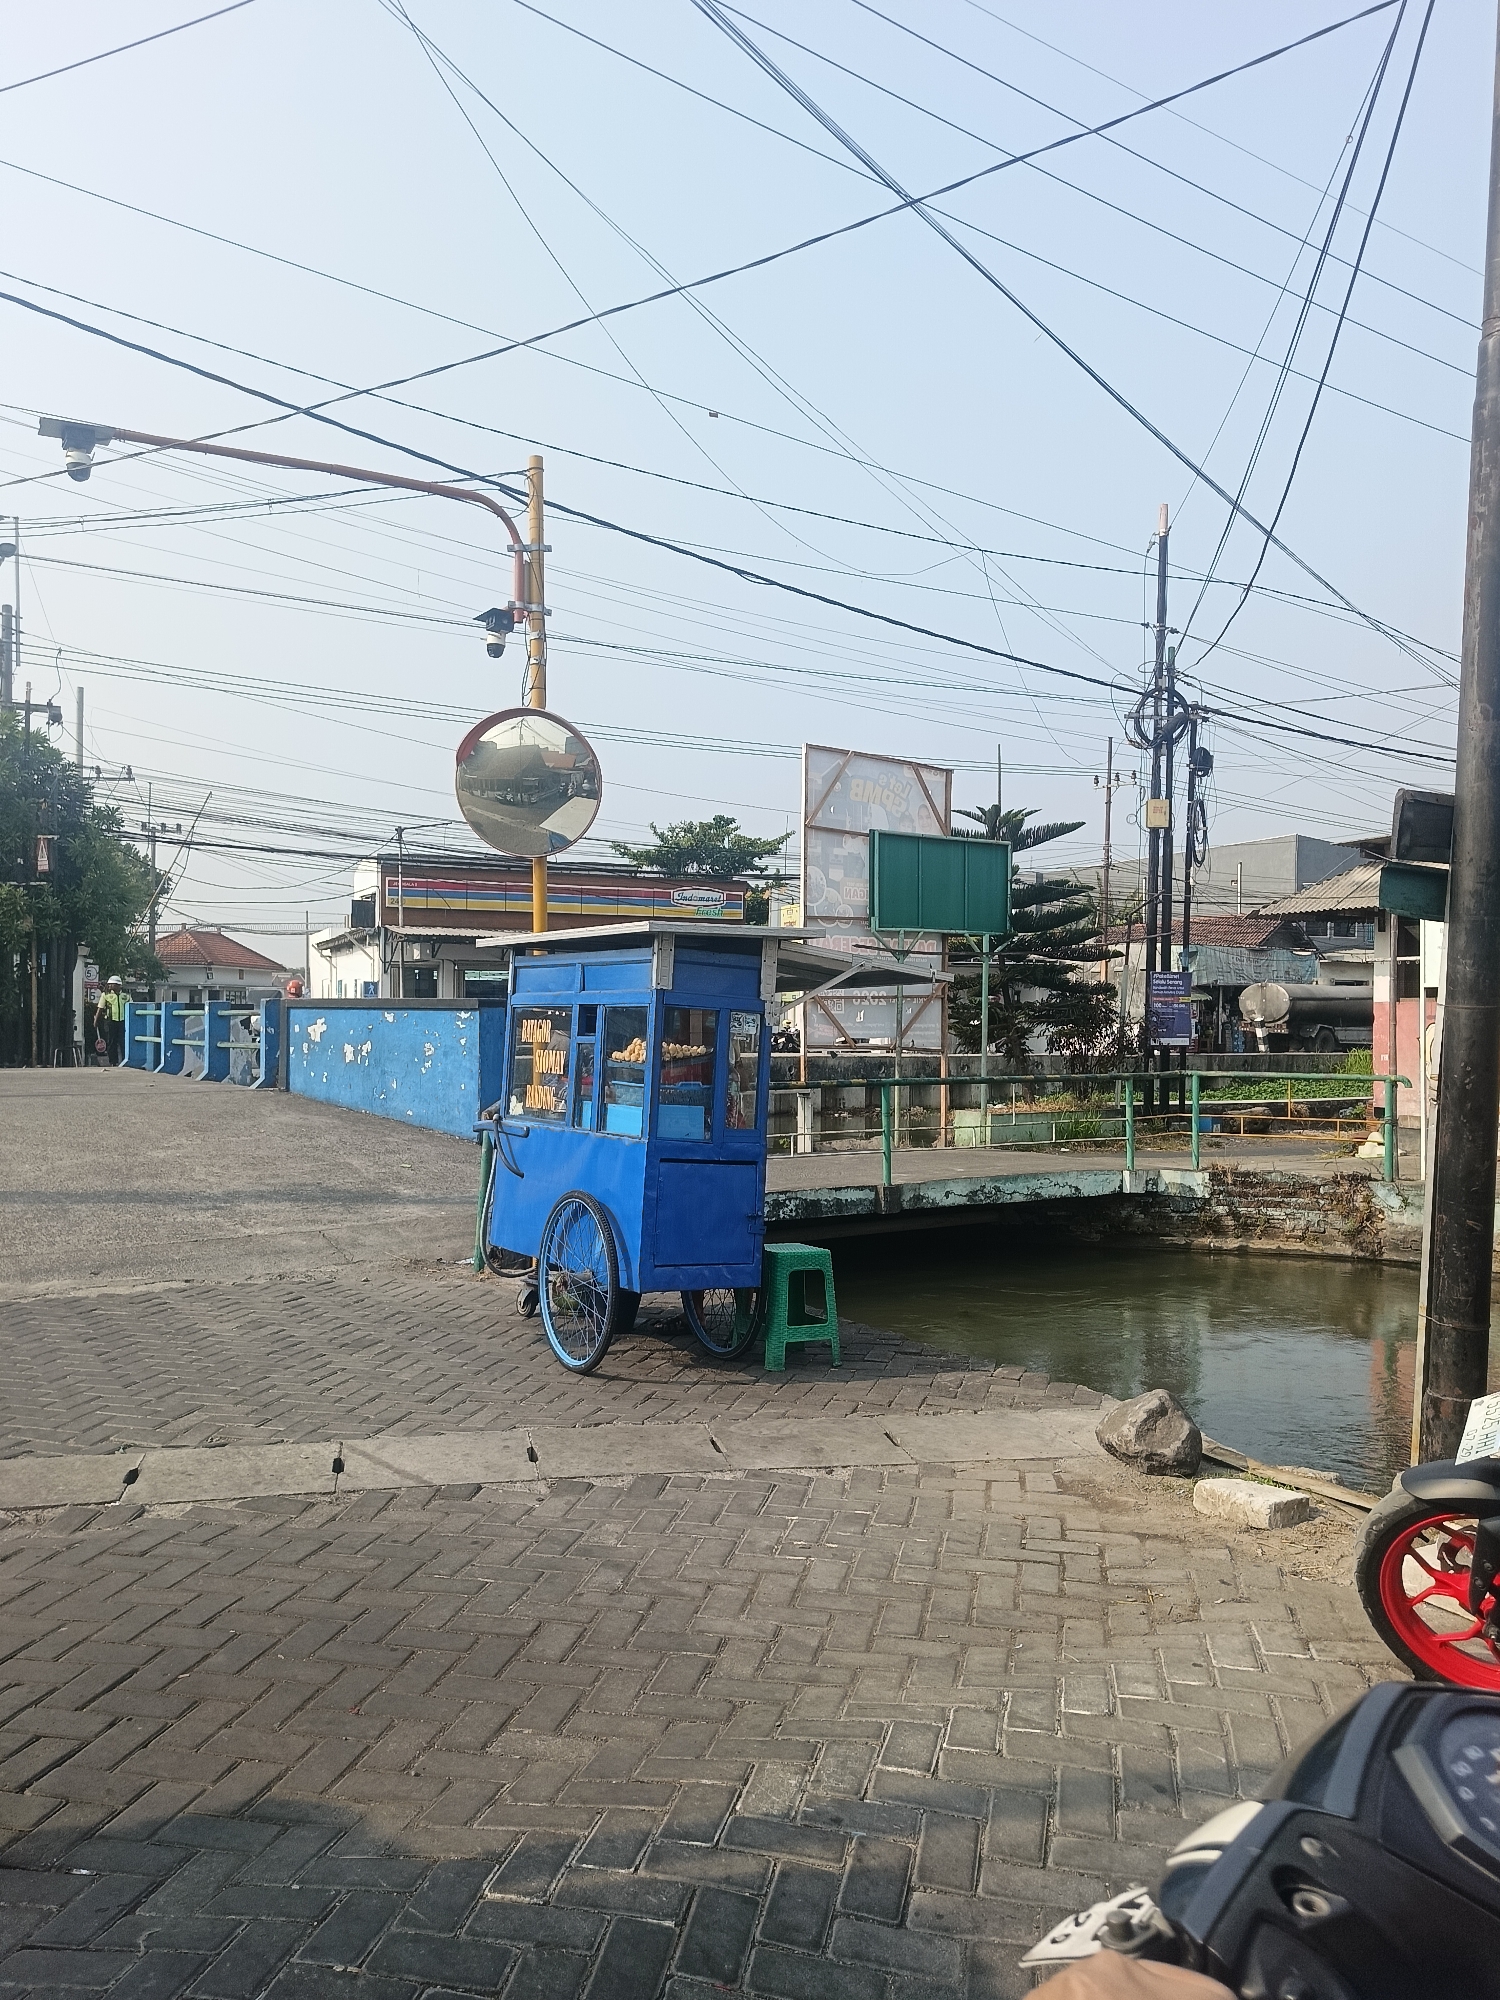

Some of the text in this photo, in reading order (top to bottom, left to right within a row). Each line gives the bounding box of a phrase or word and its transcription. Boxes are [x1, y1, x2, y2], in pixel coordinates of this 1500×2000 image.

[675, 892, 722, 903] Indomaret
[521, 1019, 552, 1043] BATAGOR
[535, 1049, 567, 1075] SIOMAY
